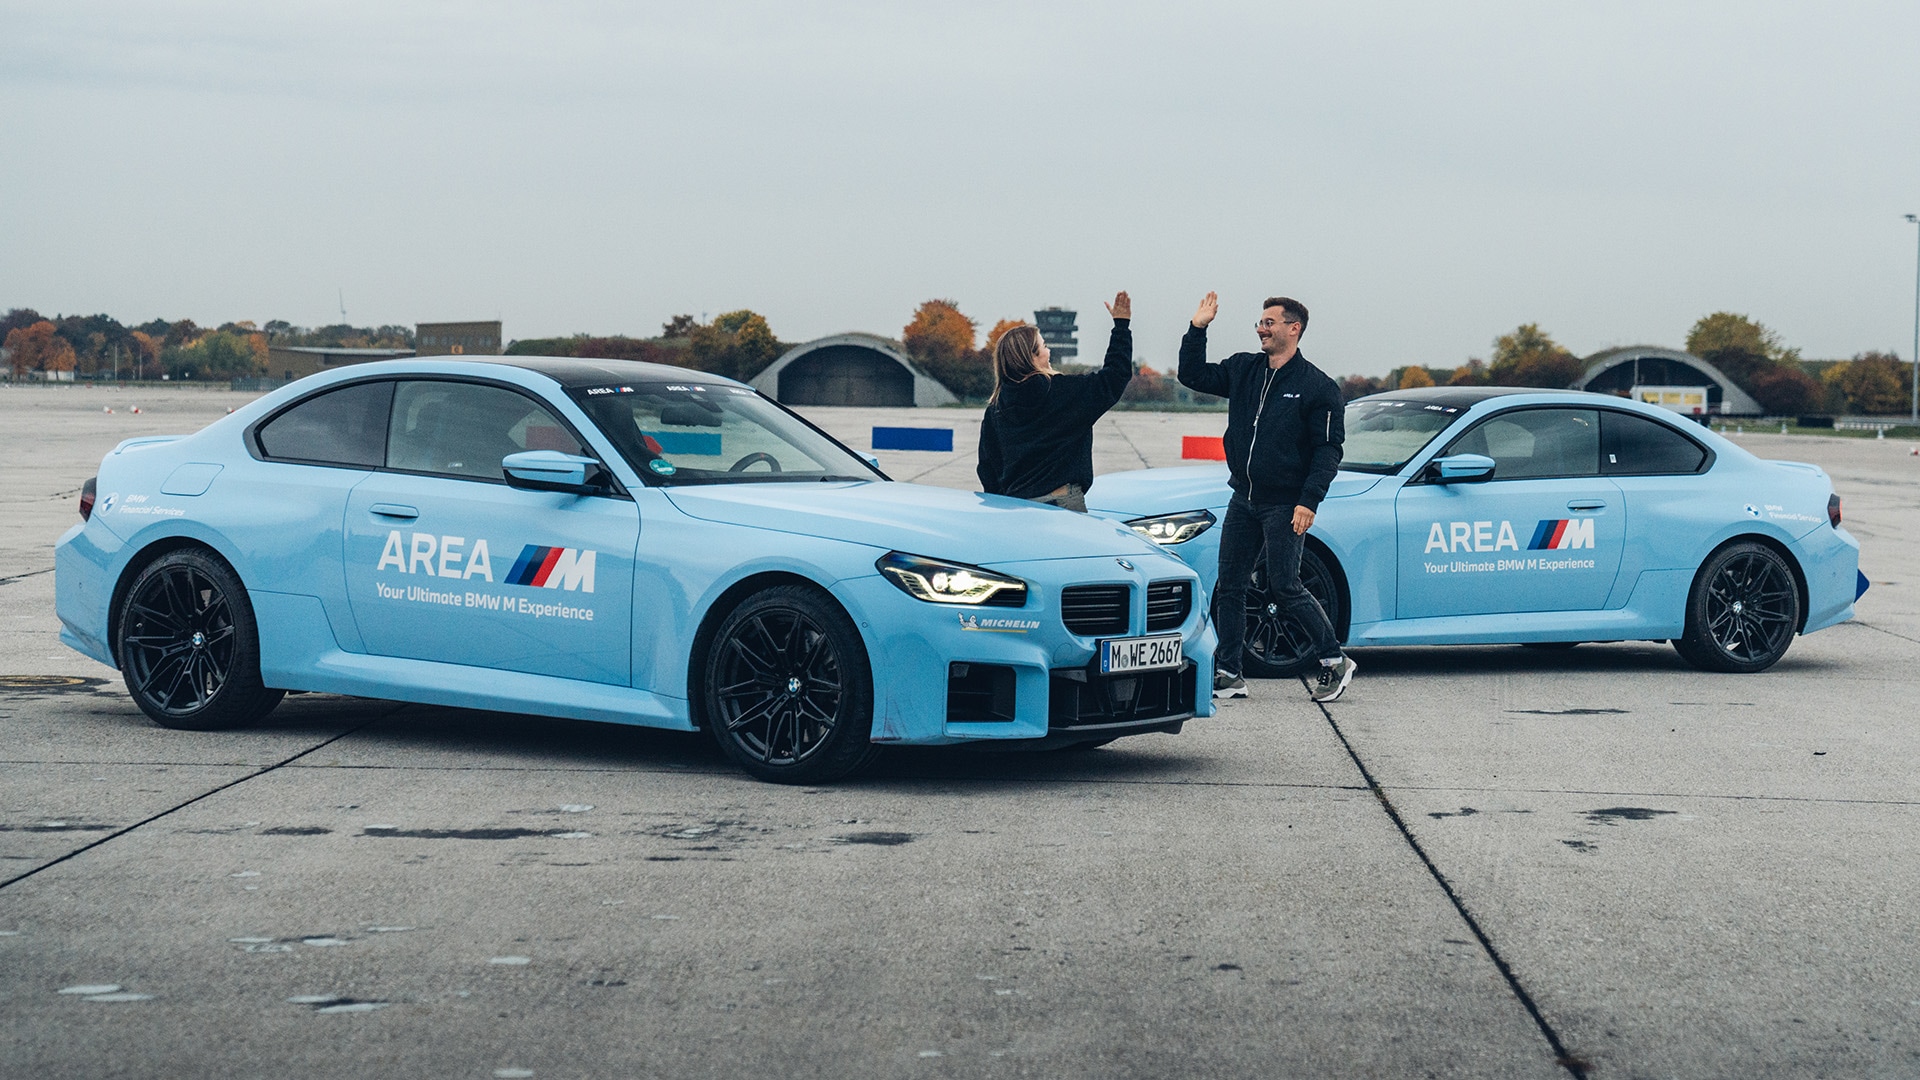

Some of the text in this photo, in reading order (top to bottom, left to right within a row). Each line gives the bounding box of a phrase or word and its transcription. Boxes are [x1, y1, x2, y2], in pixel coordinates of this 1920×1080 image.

[587, 387, 615, 396] AREA
[125, 494, 150, 503] BMW
[119, 504, 185, 516] Financial Services
[1424, 518, 1595, 554] AREA M
[377, 530, 597, 593] AREA M
[1424, 558, 1595, 573] Your Ultimate BMW M Experience
[376, 582, 594, 621] Your Ultimate BMW M Experience
[981, 618, 1040, 629] MICHELIN
[1112, 640, 1180, 669] M WE 2667
